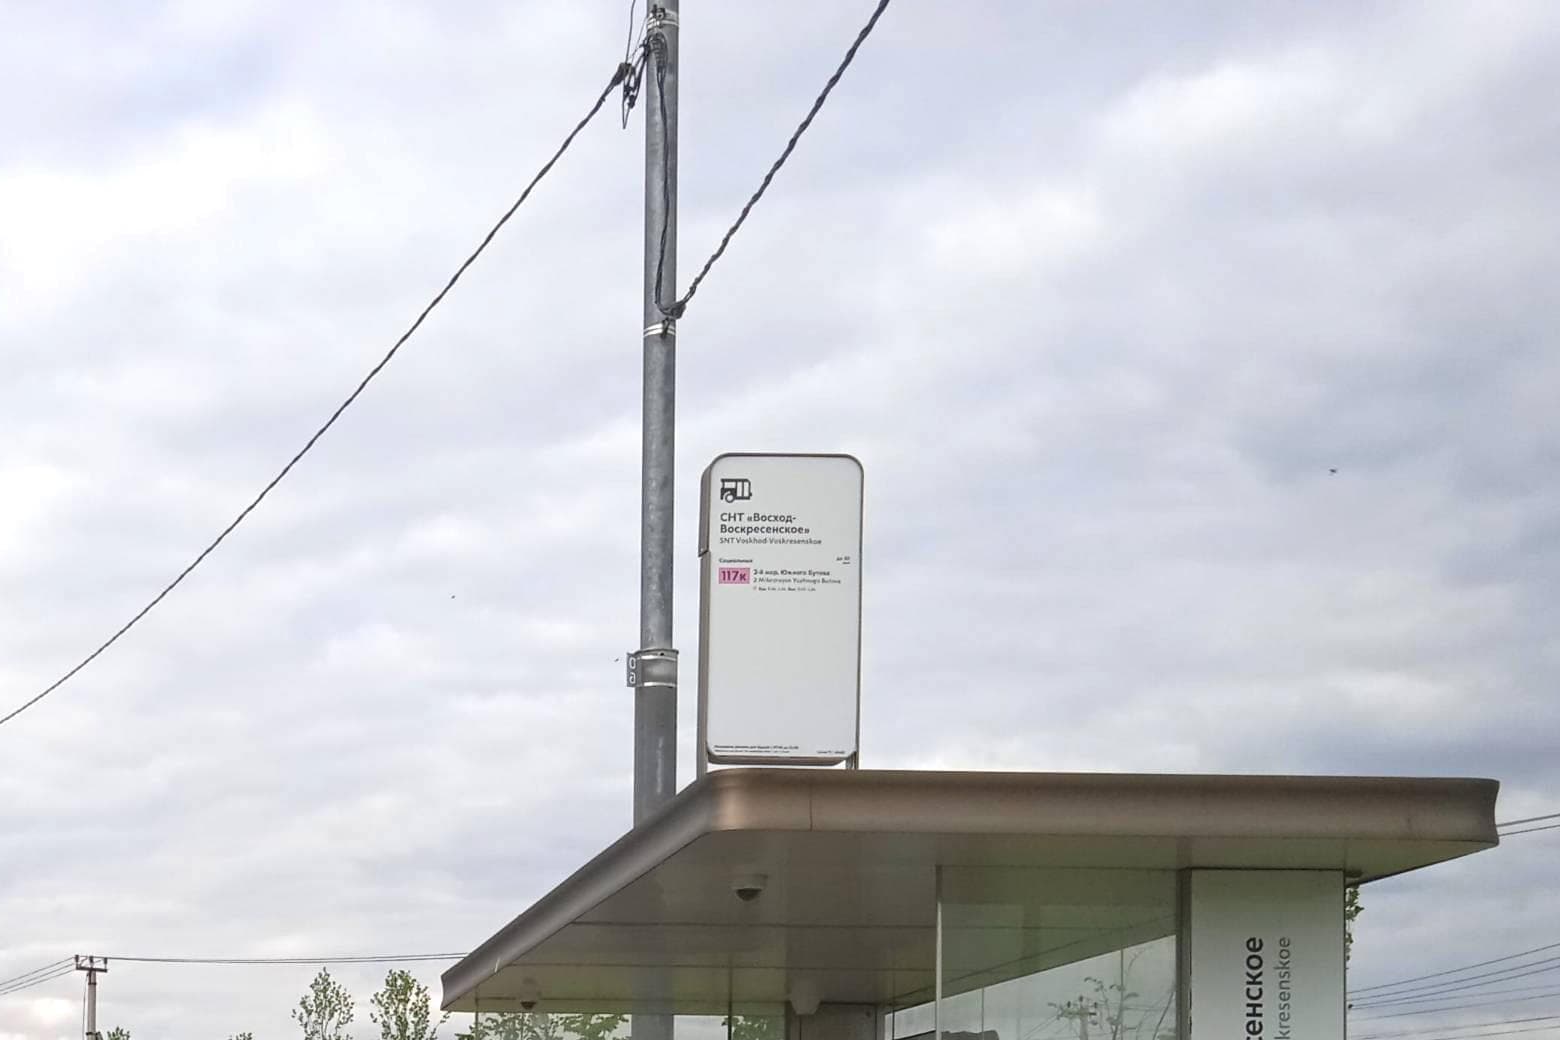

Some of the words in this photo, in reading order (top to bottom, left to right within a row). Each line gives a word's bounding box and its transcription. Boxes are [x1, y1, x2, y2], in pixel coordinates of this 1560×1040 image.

[720, 512, 744, 522] СНТ
[747, 512, 797, 523] «Восход-
[720, 524, 810, 535] Воскресенское»
[719, 537, 735, 545] SNT
[721, 571, 747, 581] 117к
